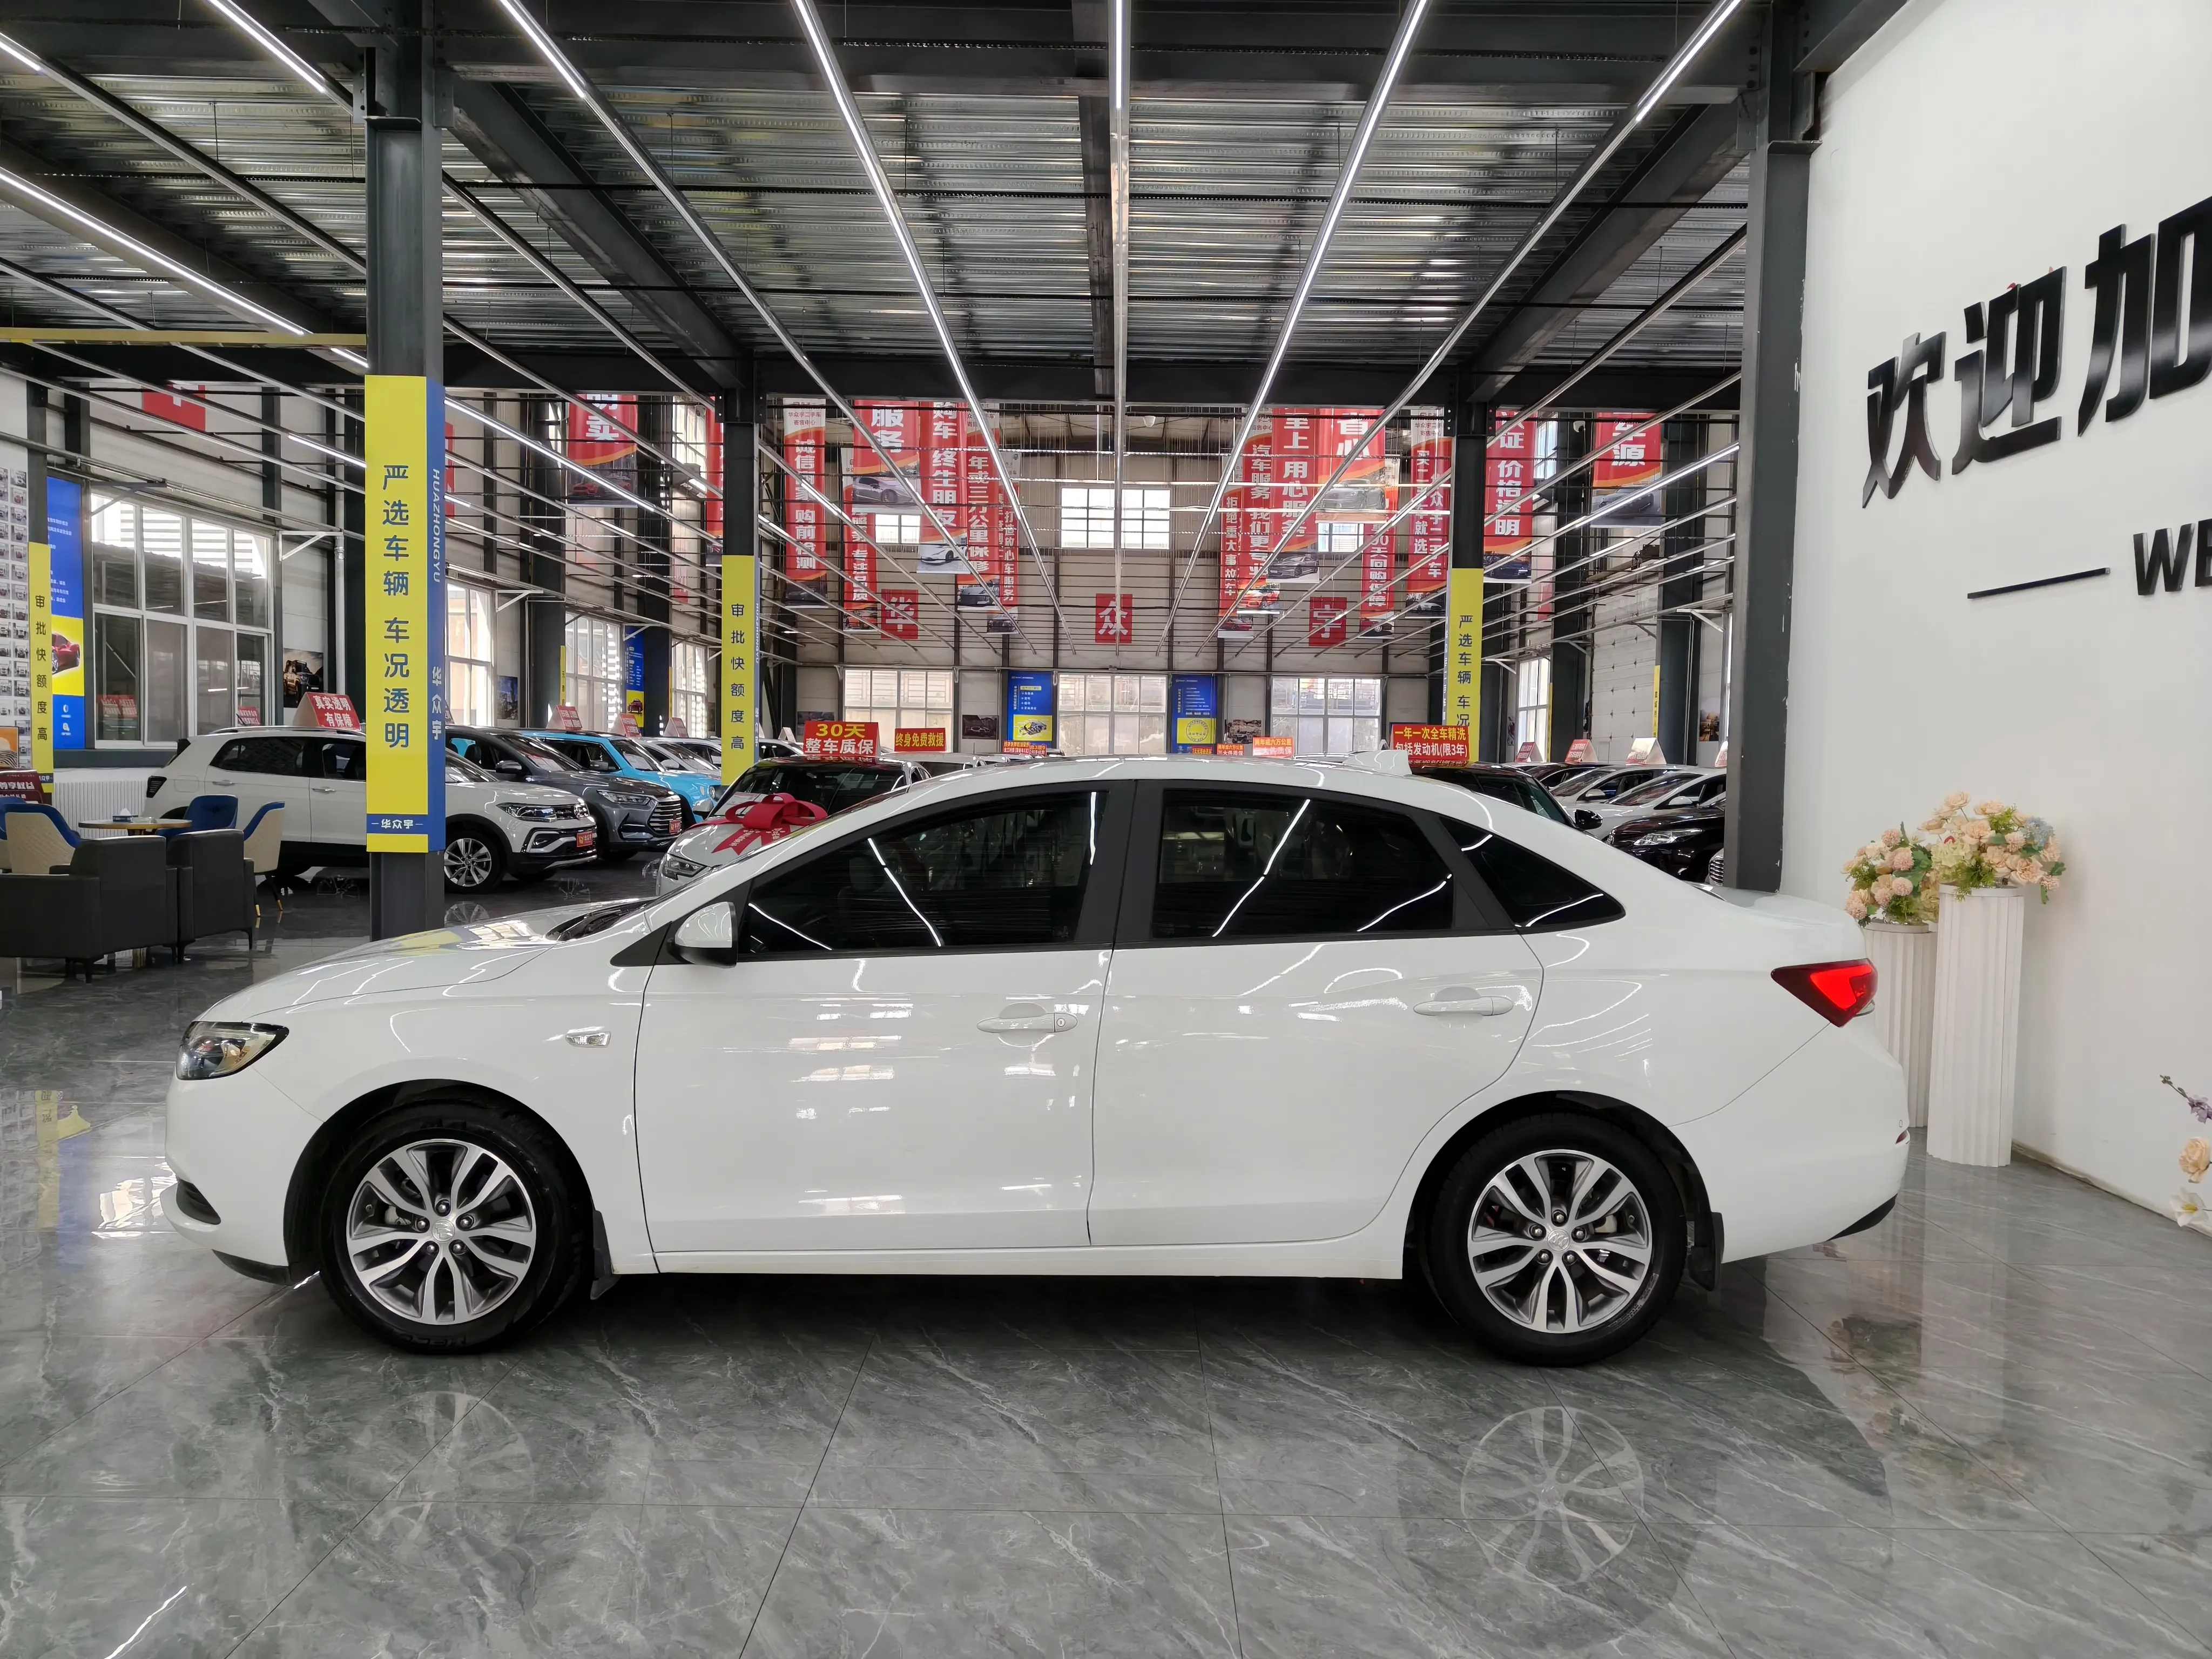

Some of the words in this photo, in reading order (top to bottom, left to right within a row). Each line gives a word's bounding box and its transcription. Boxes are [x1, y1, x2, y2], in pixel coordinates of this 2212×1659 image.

[1862, 194, 2212, 509] 欢迎加
[871, 404, 905, 453] 服务
[932, 401, 957, 439] 购车
[1284, 412, 1310, 449] 至上
[932, 449, 957, 528] 终生朋友
[1251, 444, 1272, 500] 汽车服务
[1281, 461, 1308, 537] 用心服务
[382, 464, 409, 596] 严选车辆
[433, 468, 441, 583] HUAZHONGYU
[795, 509, 817, 570] 购前检测
[1224, 496, 1238, 596] 拒绝重大事故车
[885, 596, 915, 632] 华
[1098, 601, 1128, 635] 众
[1312, 604, 1344, 638] 宇
[35, 595, 47, 741] 审批快额度高
[1457, 615, 1473, 684] 严选车辆
[383, 617, 410, 748] 车况透明
[730, 603, 745, 750] 审批快额度高
[313, 694, 351, 711] 真实透明
[325, 712, 353, 728] 有保障
[432, 666, 442, 740] 华众宇
[804, 738, 874, 755] 整车质保
[815, 723, 865, 738] 30天
[895, 732, 944, 747] 终身免费救援
[1394, 726, 1466, 741] 一年一次全车精洗
[1395, 741, 1468, 758] 包括发动机(限3年)
[381, 818, 414, 830] 华众宇
